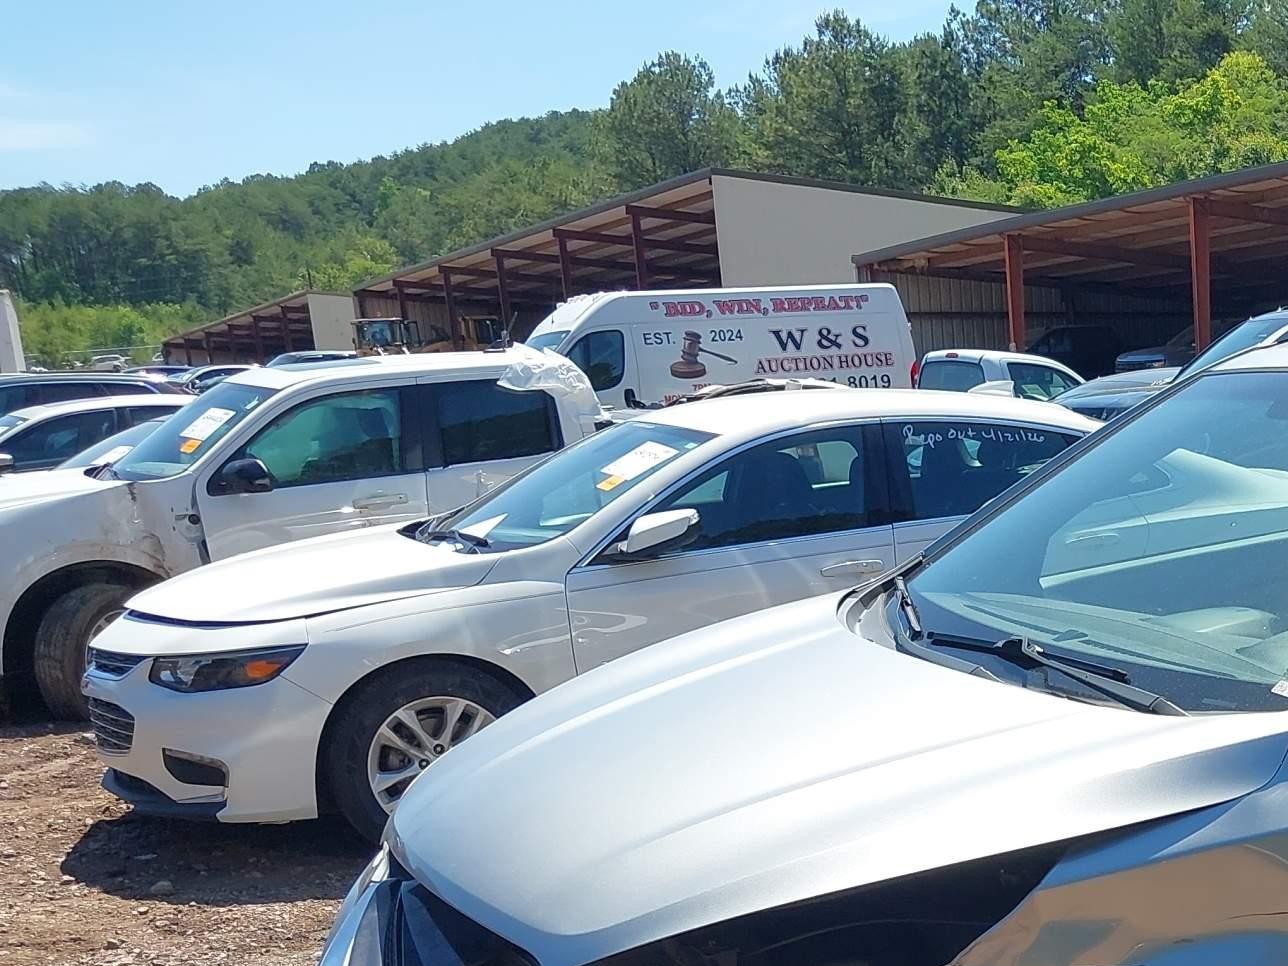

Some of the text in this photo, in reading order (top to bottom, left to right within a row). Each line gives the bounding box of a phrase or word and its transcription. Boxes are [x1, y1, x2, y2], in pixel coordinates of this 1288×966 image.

[712, 299, 769, 317] WIN,
[642, 328, 744, 346] EST. 2024
[768, 325, 870, 351] W & S
[755, 352, 895, 374] AUCTION HOUSE
